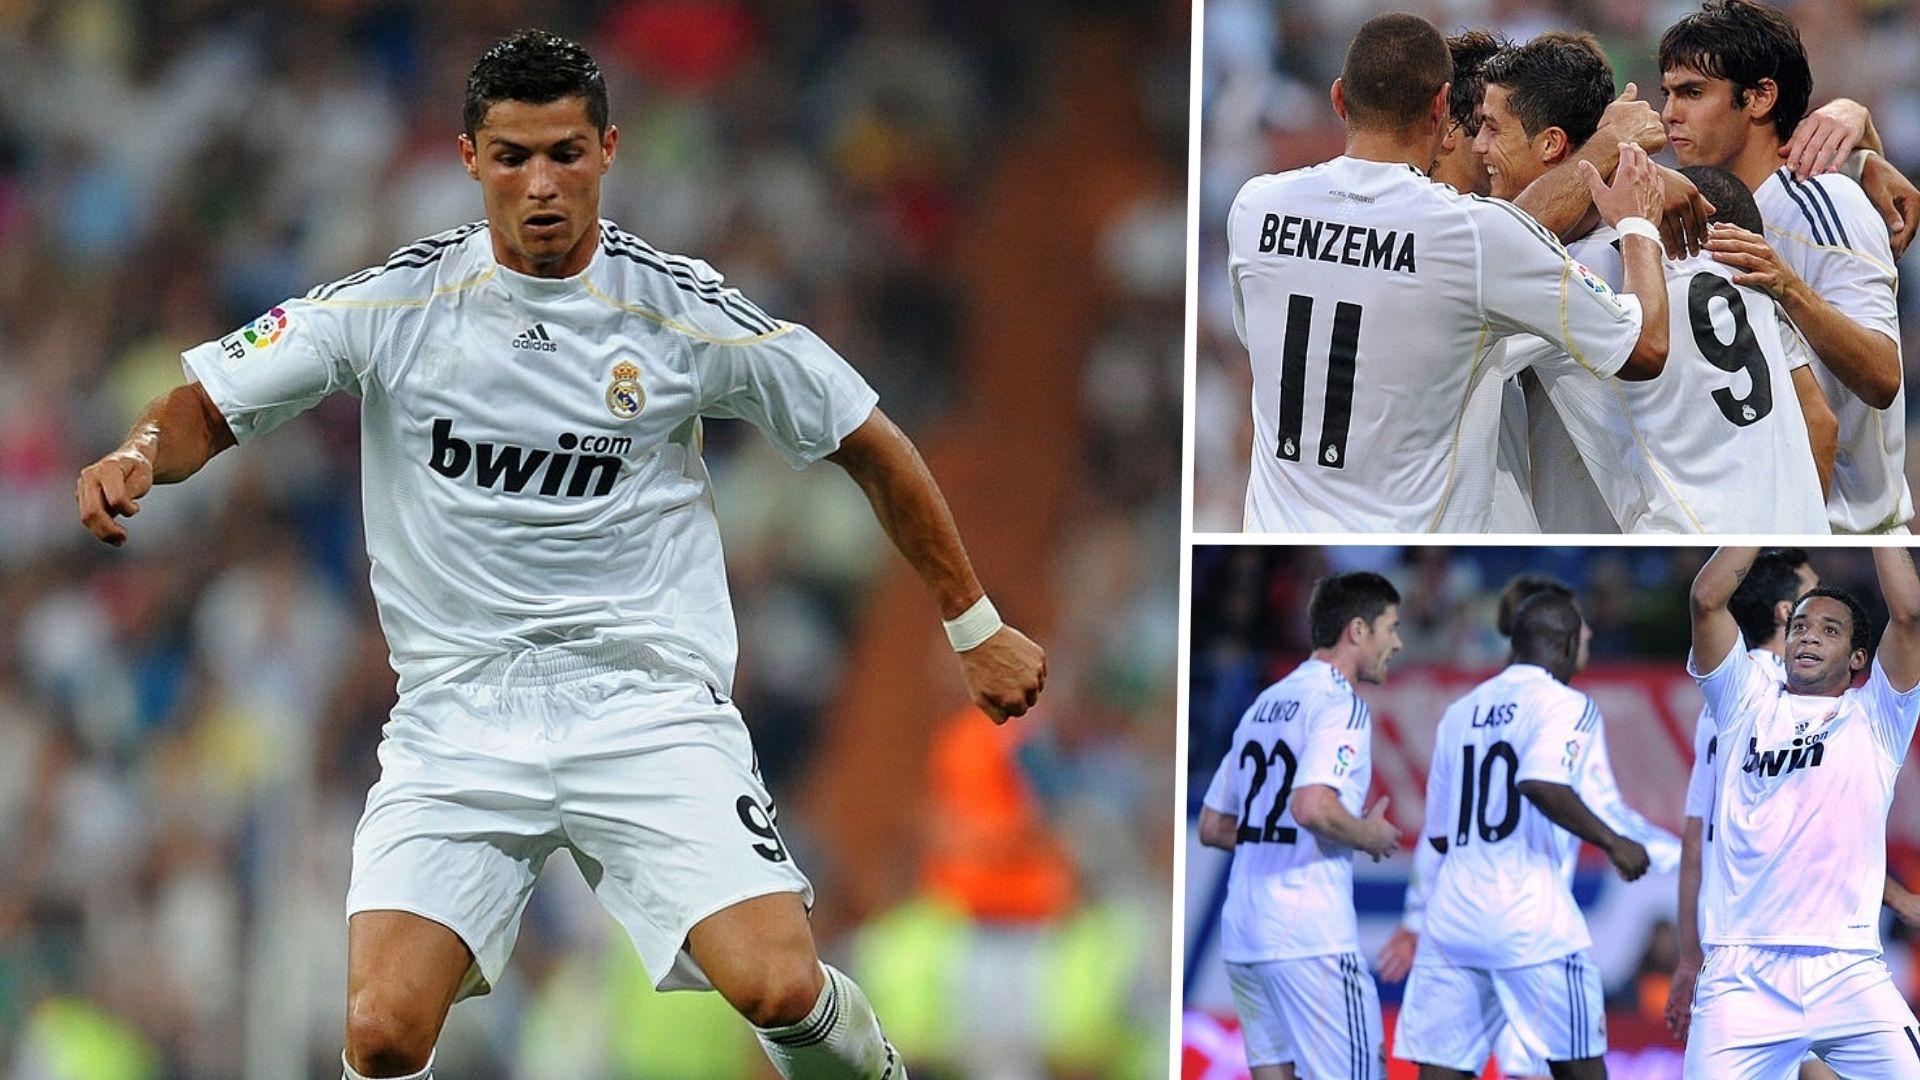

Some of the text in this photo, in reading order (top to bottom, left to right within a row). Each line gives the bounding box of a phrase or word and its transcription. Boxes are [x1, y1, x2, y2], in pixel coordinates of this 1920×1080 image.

[1258, 213, 1416, 273] BENZEMA
[221, 334, 245, 359] LFP
[512, 339, 557, 352] adidas
[1276, 293, 1362, 469] 11
[1688, 271, 1773, 427] 9
[428, 419, 632, 497] bwin com
[1472, 703, 1518, 728] LASS
[1236, 738, 1297, 845] 22
[1456, 740, 1521, 847] 10
[736, 795, 787, 862] 9
